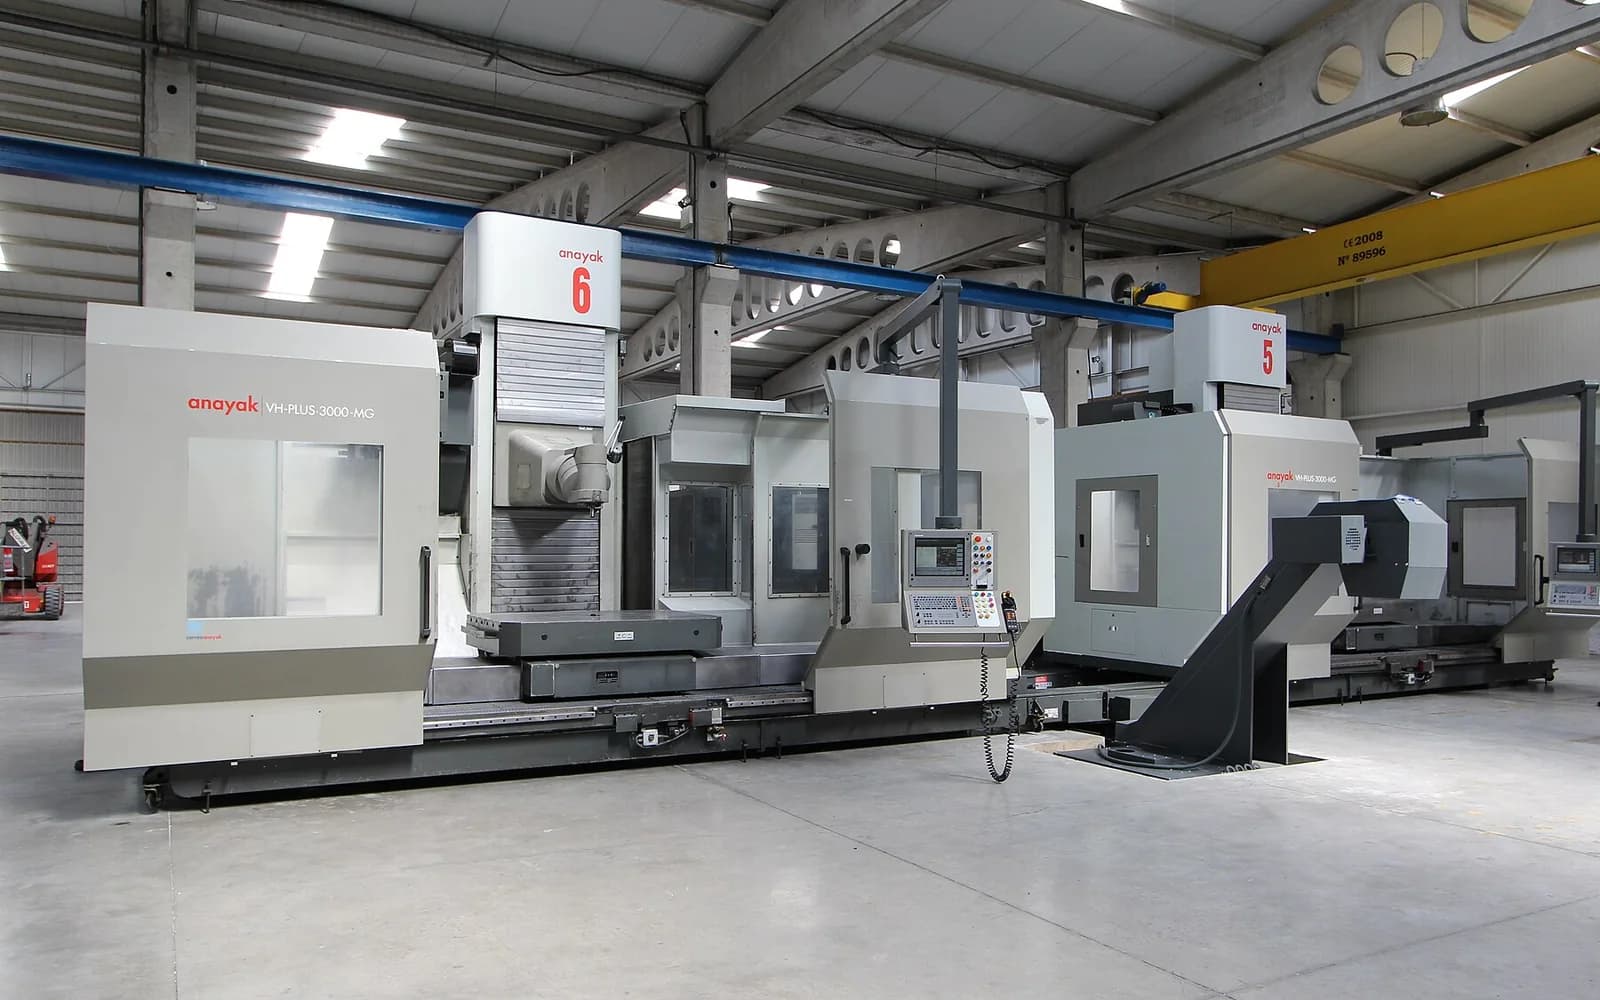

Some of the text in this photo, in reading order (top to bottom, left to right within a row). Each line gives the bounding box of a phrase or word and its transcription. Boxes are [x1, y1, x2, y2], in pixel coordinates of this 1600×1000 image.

[1354, 231, 1383, 245] 2008
[559, 250, 603, 264] anayak
[1352, 246, 1386, 262] 89596
[573, 266, 591, 314] 6
[1252, 322, 1281, 335] anayak
[1263, 339, 1273, 375] 5
[188, 395, 258, 415] anayak
[1267, 471, 1294, 483] anayak
